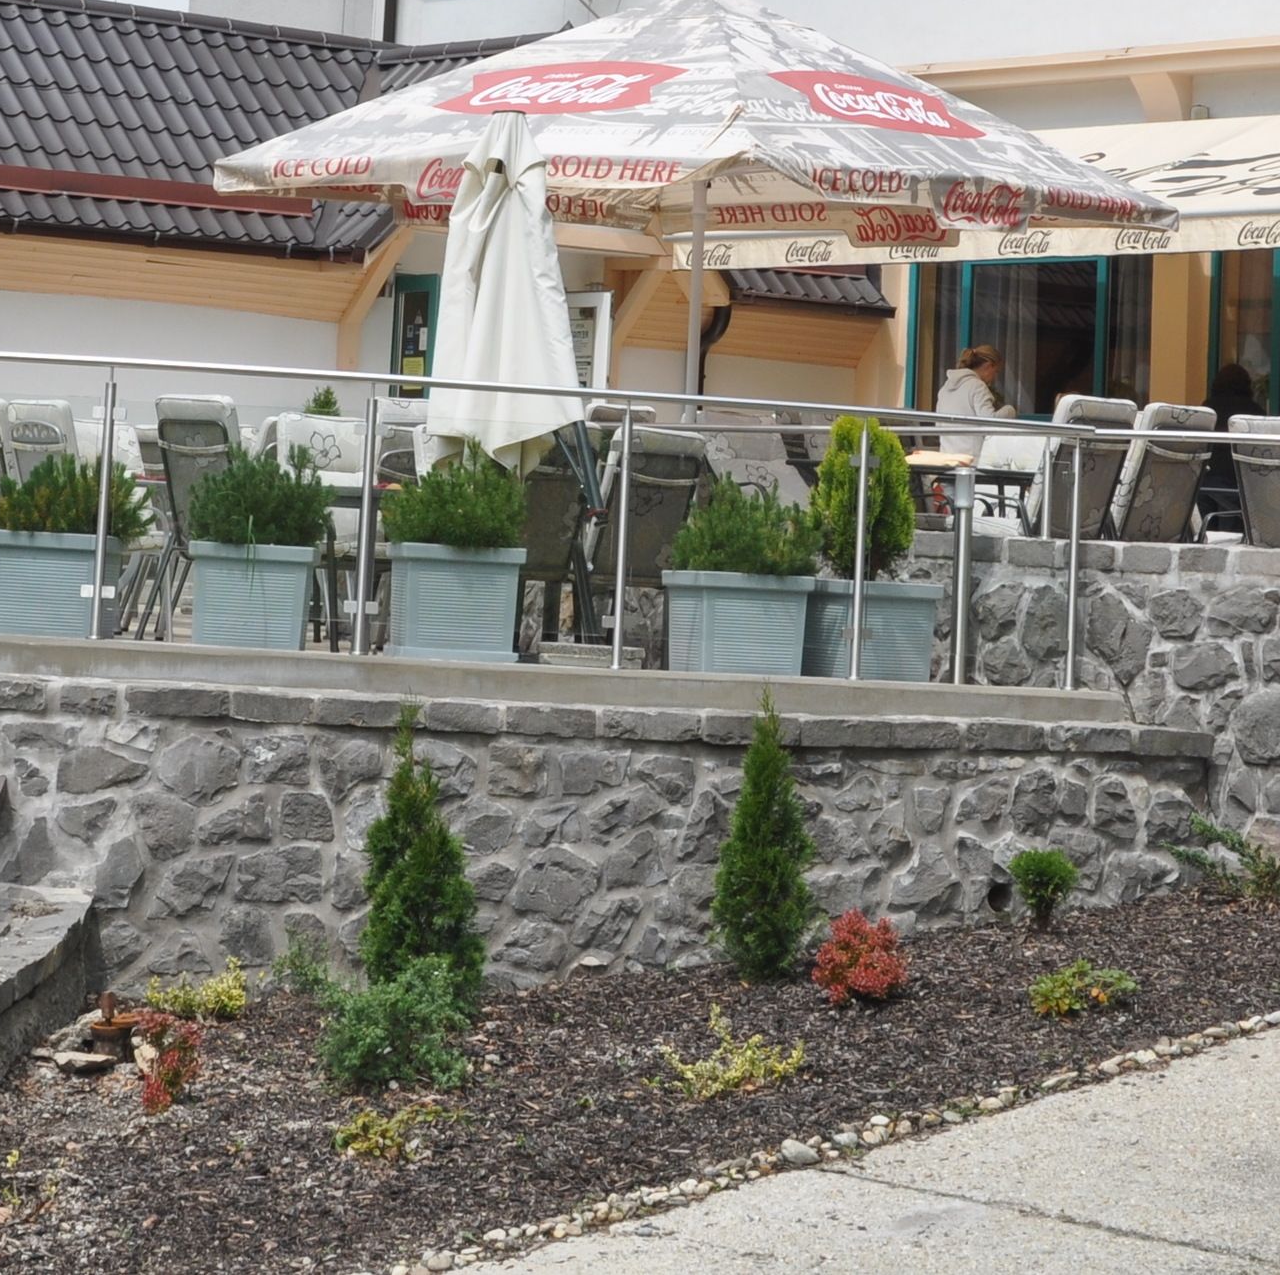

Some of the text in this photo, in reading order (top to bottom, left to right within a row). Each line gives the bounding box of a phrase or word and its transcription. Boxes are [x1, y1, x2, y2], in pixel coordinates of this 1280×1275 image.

[273, 156, 373, 178] ICE COLD
[548, 155, 683, 183] SOLD HERE
[812, 168, 842, 192] ICE
[848, 169, 903, 193] COLD
[1046, 185, 1092, 210] SOLD
